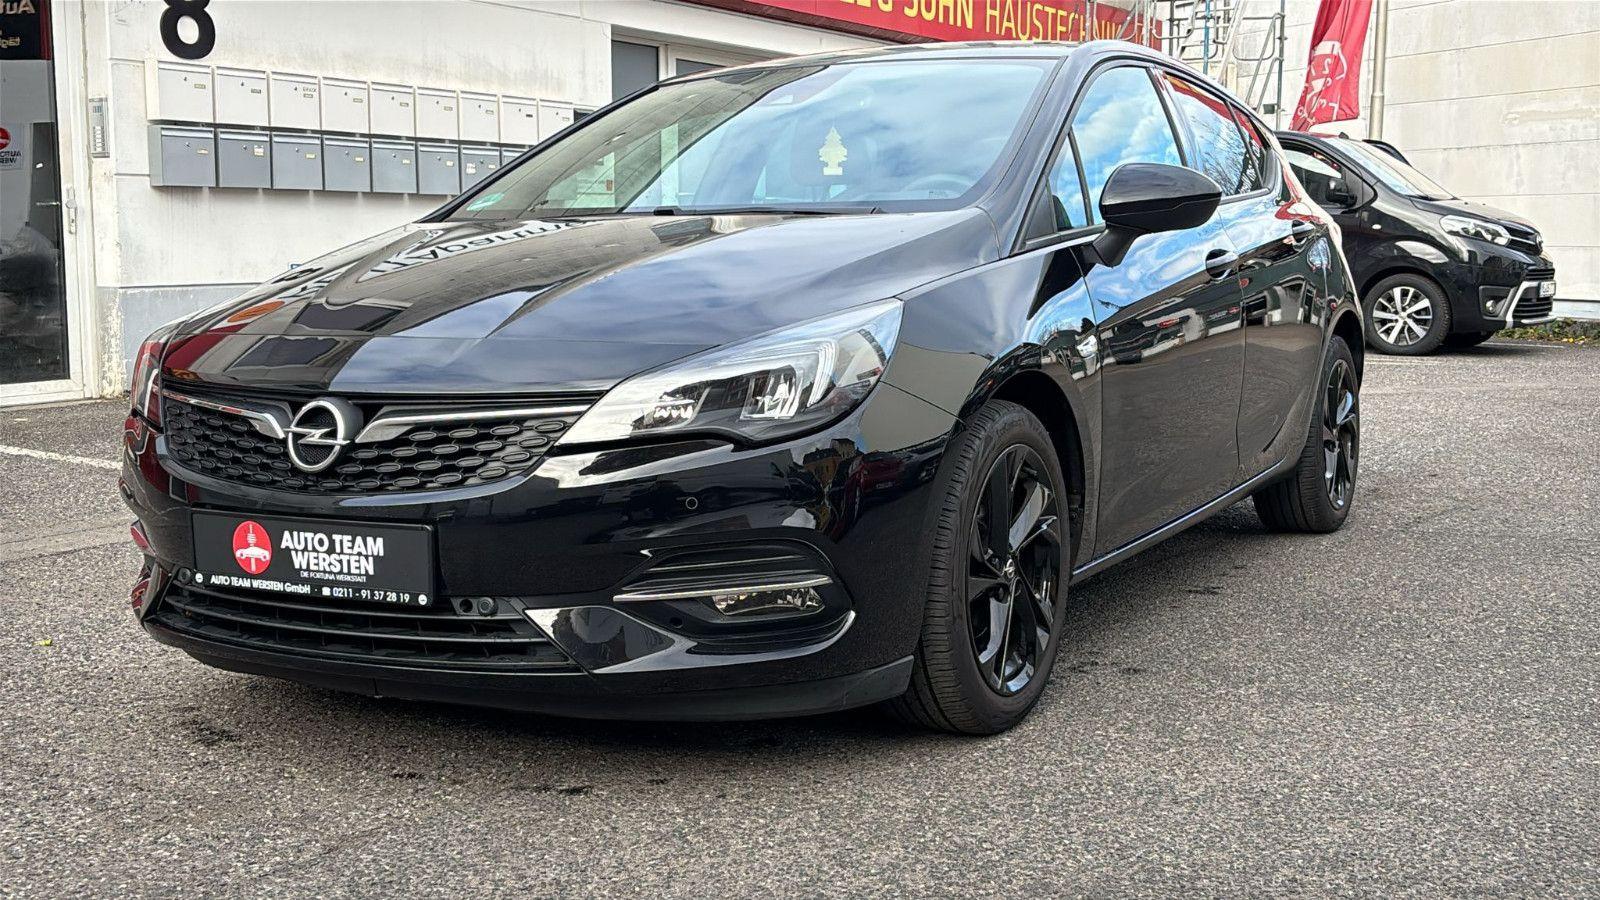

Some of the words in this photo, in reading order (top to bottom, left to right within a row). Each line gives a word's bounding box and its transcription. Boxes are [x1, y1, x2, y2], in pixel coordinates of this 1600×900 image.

[160, 0, 215, 60] 8
[280, 530, 329, 552] AUTO
[332, 534, 384, 557] TEAM
[291, 550, 375, 575] WERSTEN
[210, 574, 230, 585] AUTO
[230, 576, 251, 588] TEAM
[251, 579, 283, 592] WERSTEN
[284, 582, 311, 594] GmbH
[333, 587, 353, 597] 0211
[361, 590, 371, 600] 91
[373, 591, 385, 601] 37
[386, 592, 397, 602] 28
[400, 593, 410, 603] 19
[300, 570, 309, 578] DIE
[310, 571, 335, 580] FORTUNA
[336, 574, 366, 583] WERKSTATT
